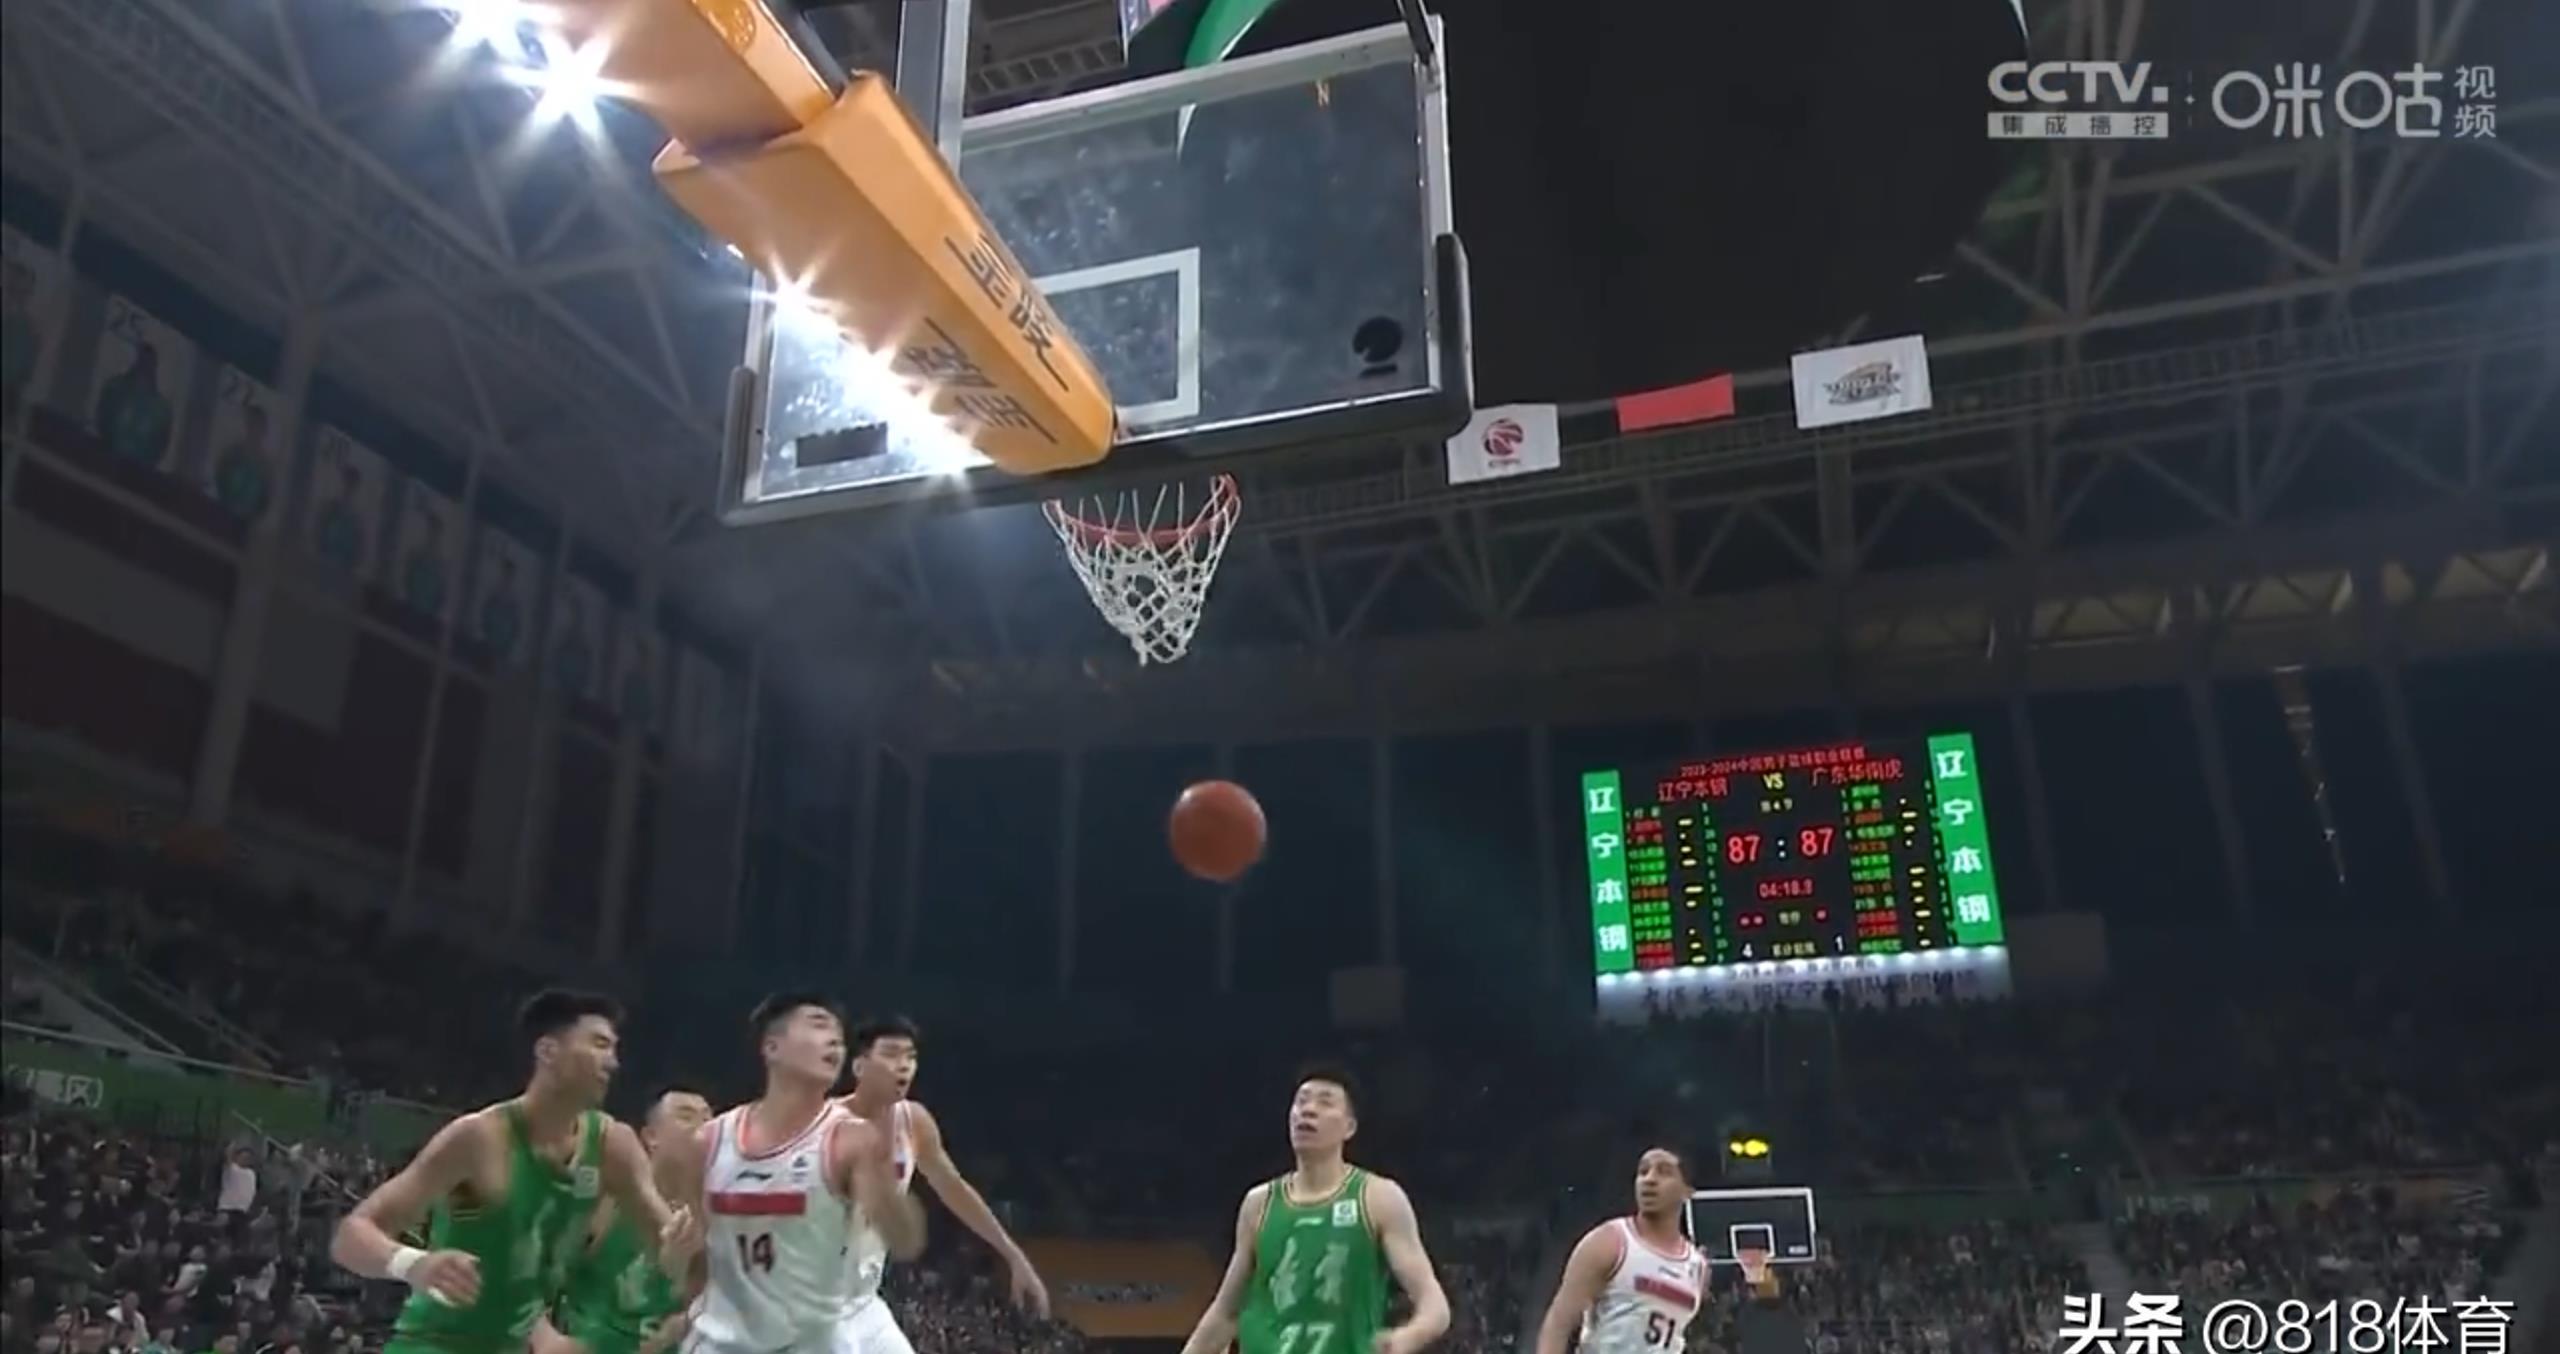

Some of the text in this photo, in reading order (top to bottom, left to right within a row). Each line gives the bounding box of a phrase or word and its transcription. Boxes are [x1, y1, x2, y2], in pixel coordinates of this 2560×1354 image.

[1764, 773, 1784, 790] VS
[1728, 836, 1761, 864] 87
[1801, 829, 1835, 856] 87
[1936, 750, 1990, 923] 辽宁本钢
[1588, 786, 1628, 952] 辽宁本钢
[1742, 942, 1753, 958] 4
[1835, 935, 1844, 952] 1
[737, 1231, 776, 1272] 14
[1644, 1311, 1676, 1350] 51
